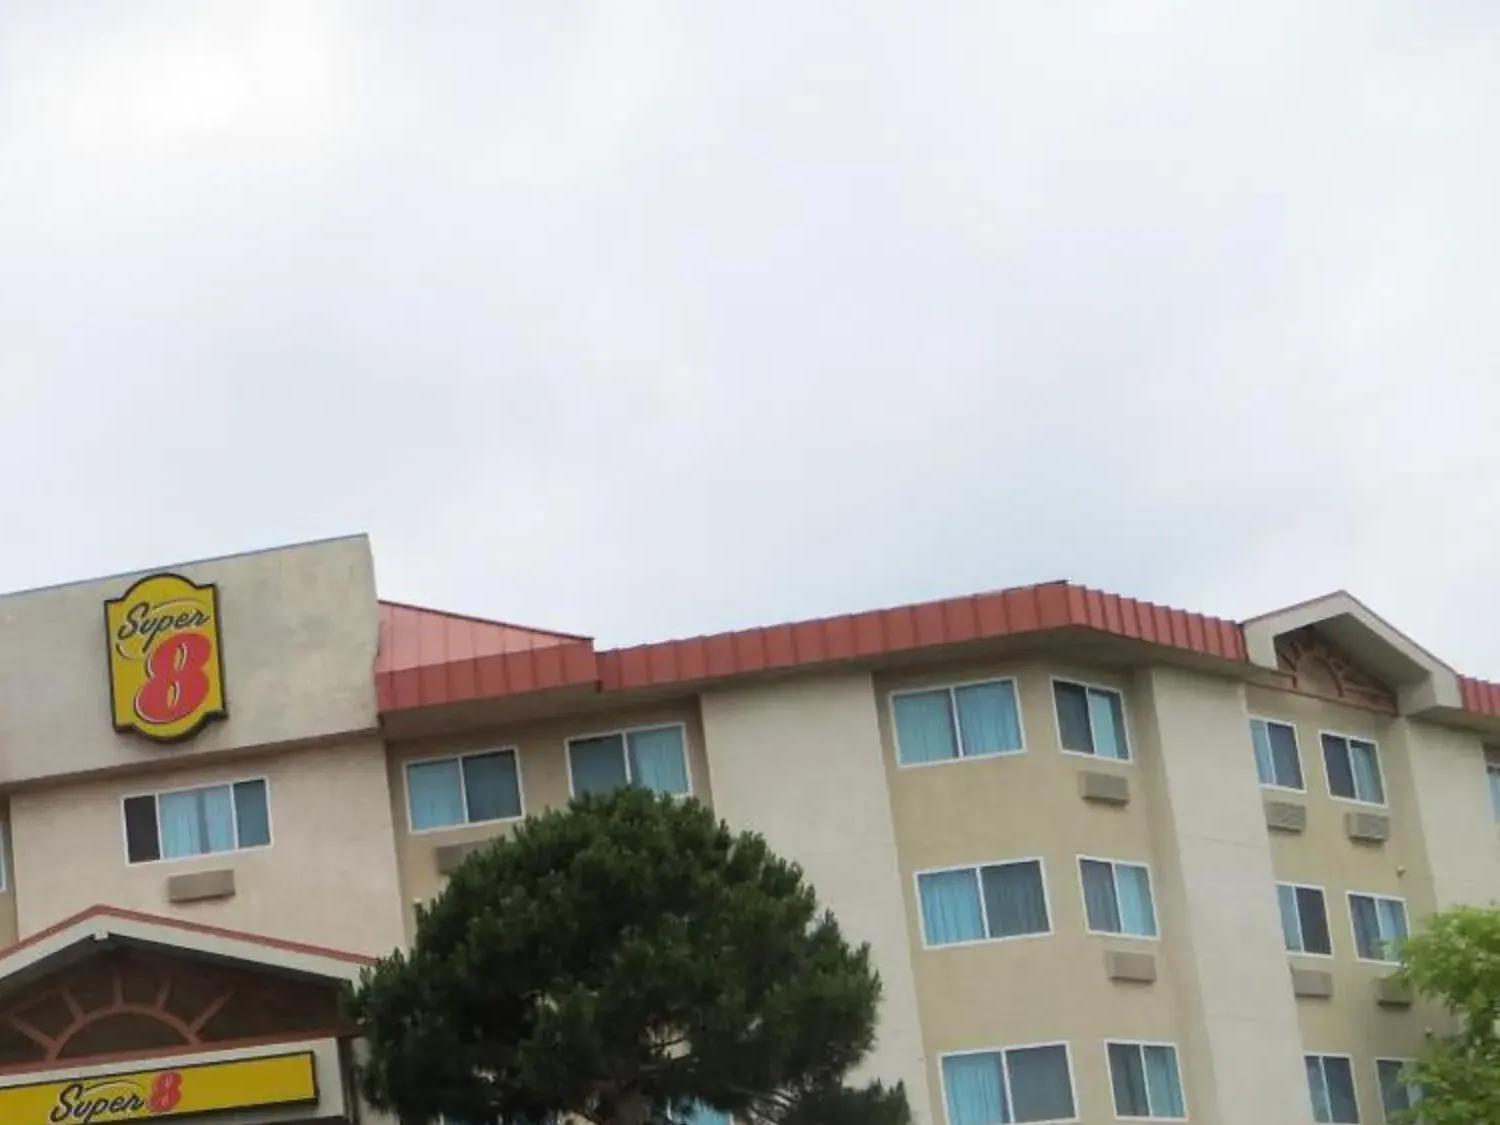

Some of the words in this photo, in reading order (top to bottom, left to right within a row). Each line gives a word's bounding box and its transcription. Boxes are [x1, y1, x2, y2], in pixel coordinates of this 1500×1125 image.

[118, 602, 210, 653] Super
[134, 632, 212, 724] 8
[50, 1083, 145, 1123] Super
[149, 1073, 183, 1113] 8
